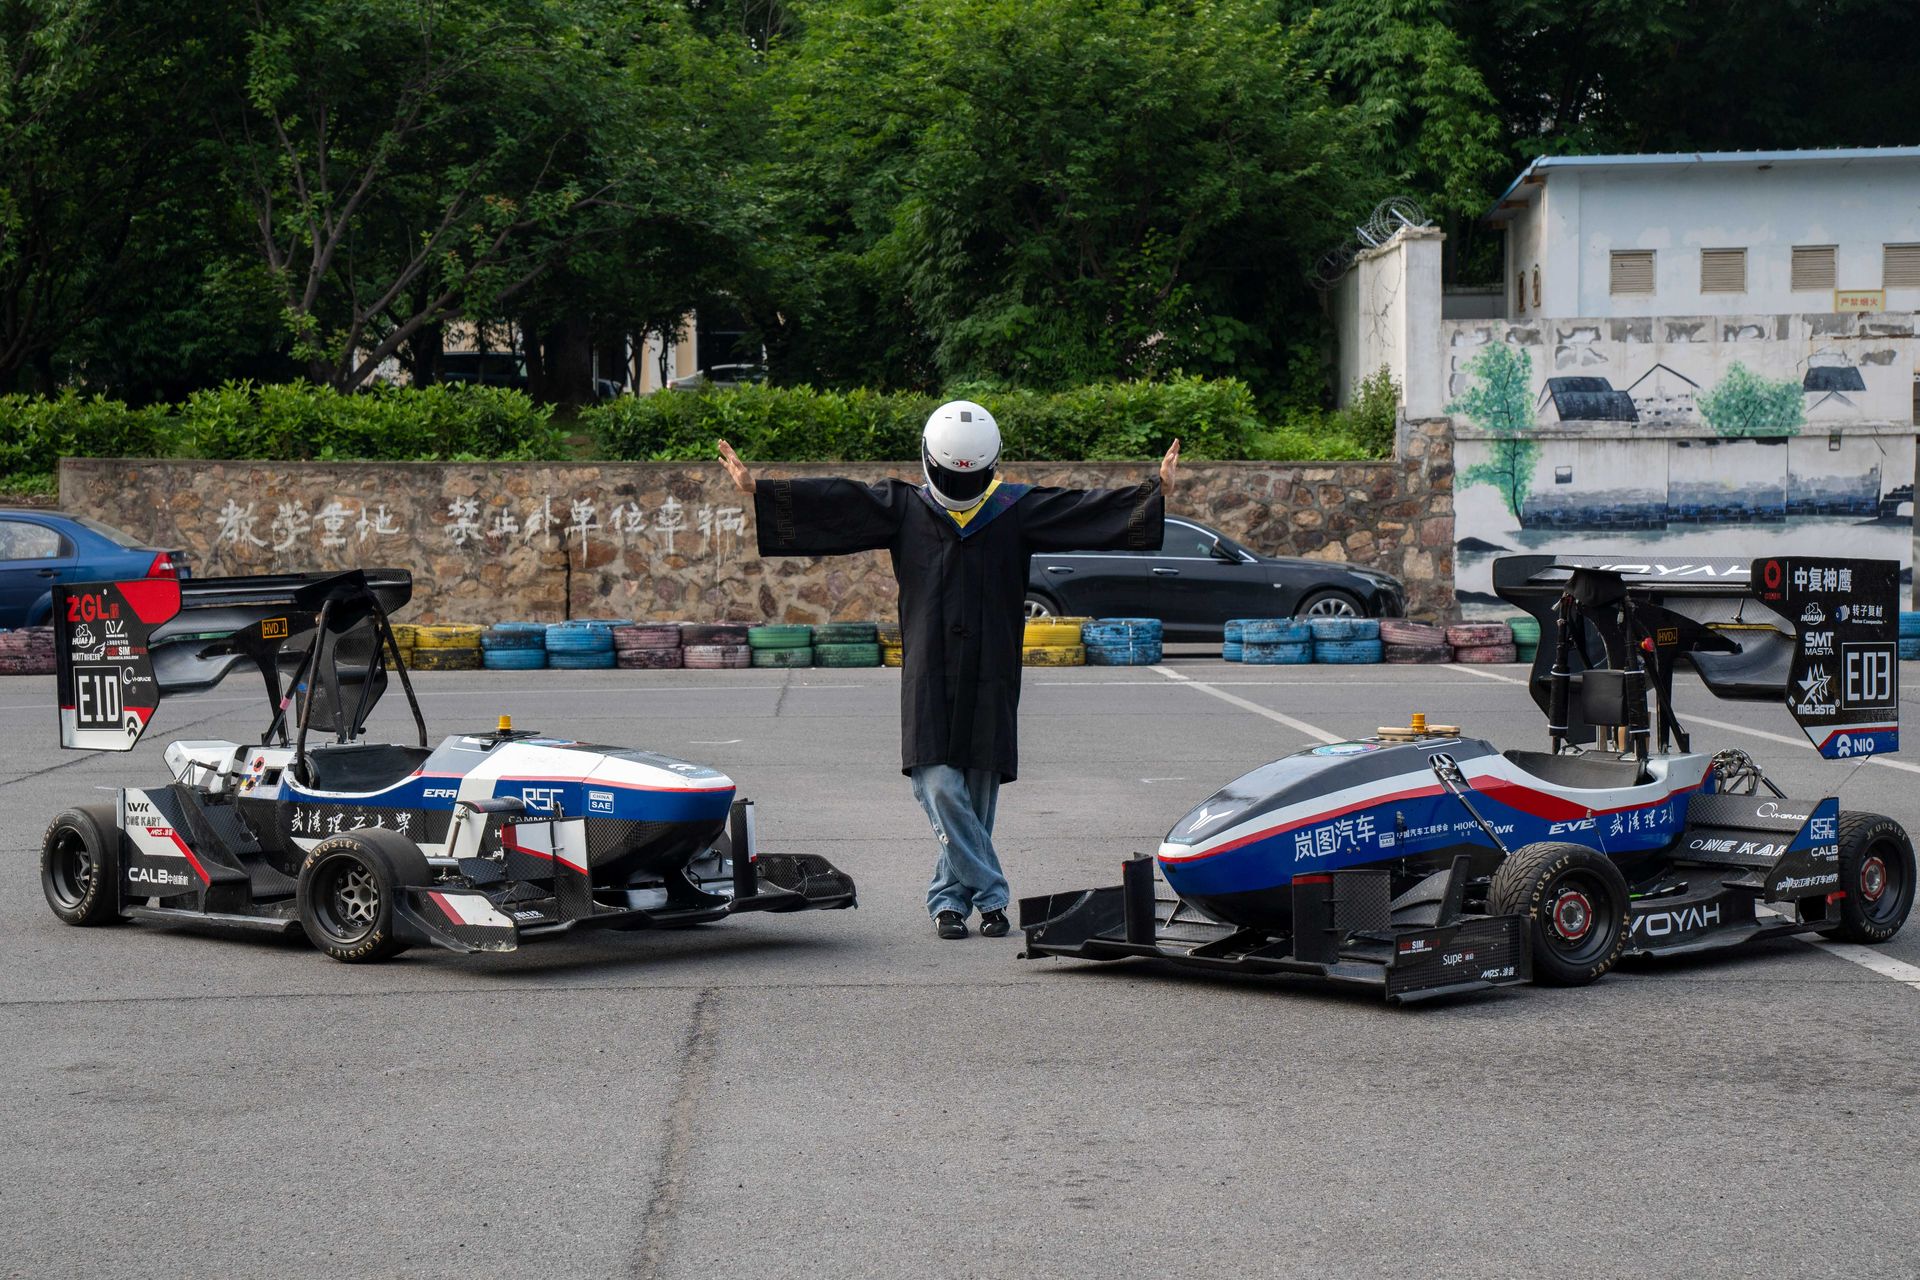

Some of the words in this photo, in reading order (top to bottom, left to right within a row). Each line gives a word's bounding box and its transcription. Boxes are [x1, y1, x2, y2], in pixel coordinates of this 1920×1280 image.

[1794, 567, 1852, 593] 中复神鹰
[264, 622, 279, 635] HVD
[1805, 631, 1834, 647] SMT
[1804, 647, 1834, 655] MASTA
[1854, 737, 1875, 753] NIO
[591, 801, 611, 810] SAE
[141, 816, 161, 827] KART
[1453, 820, 1478, 832] HIOKI
[1294, 814, 1376, 862] 岚图汽车
[1811, 844, 1838, 857] CALB
[128, 867, 168, 884] CALB
